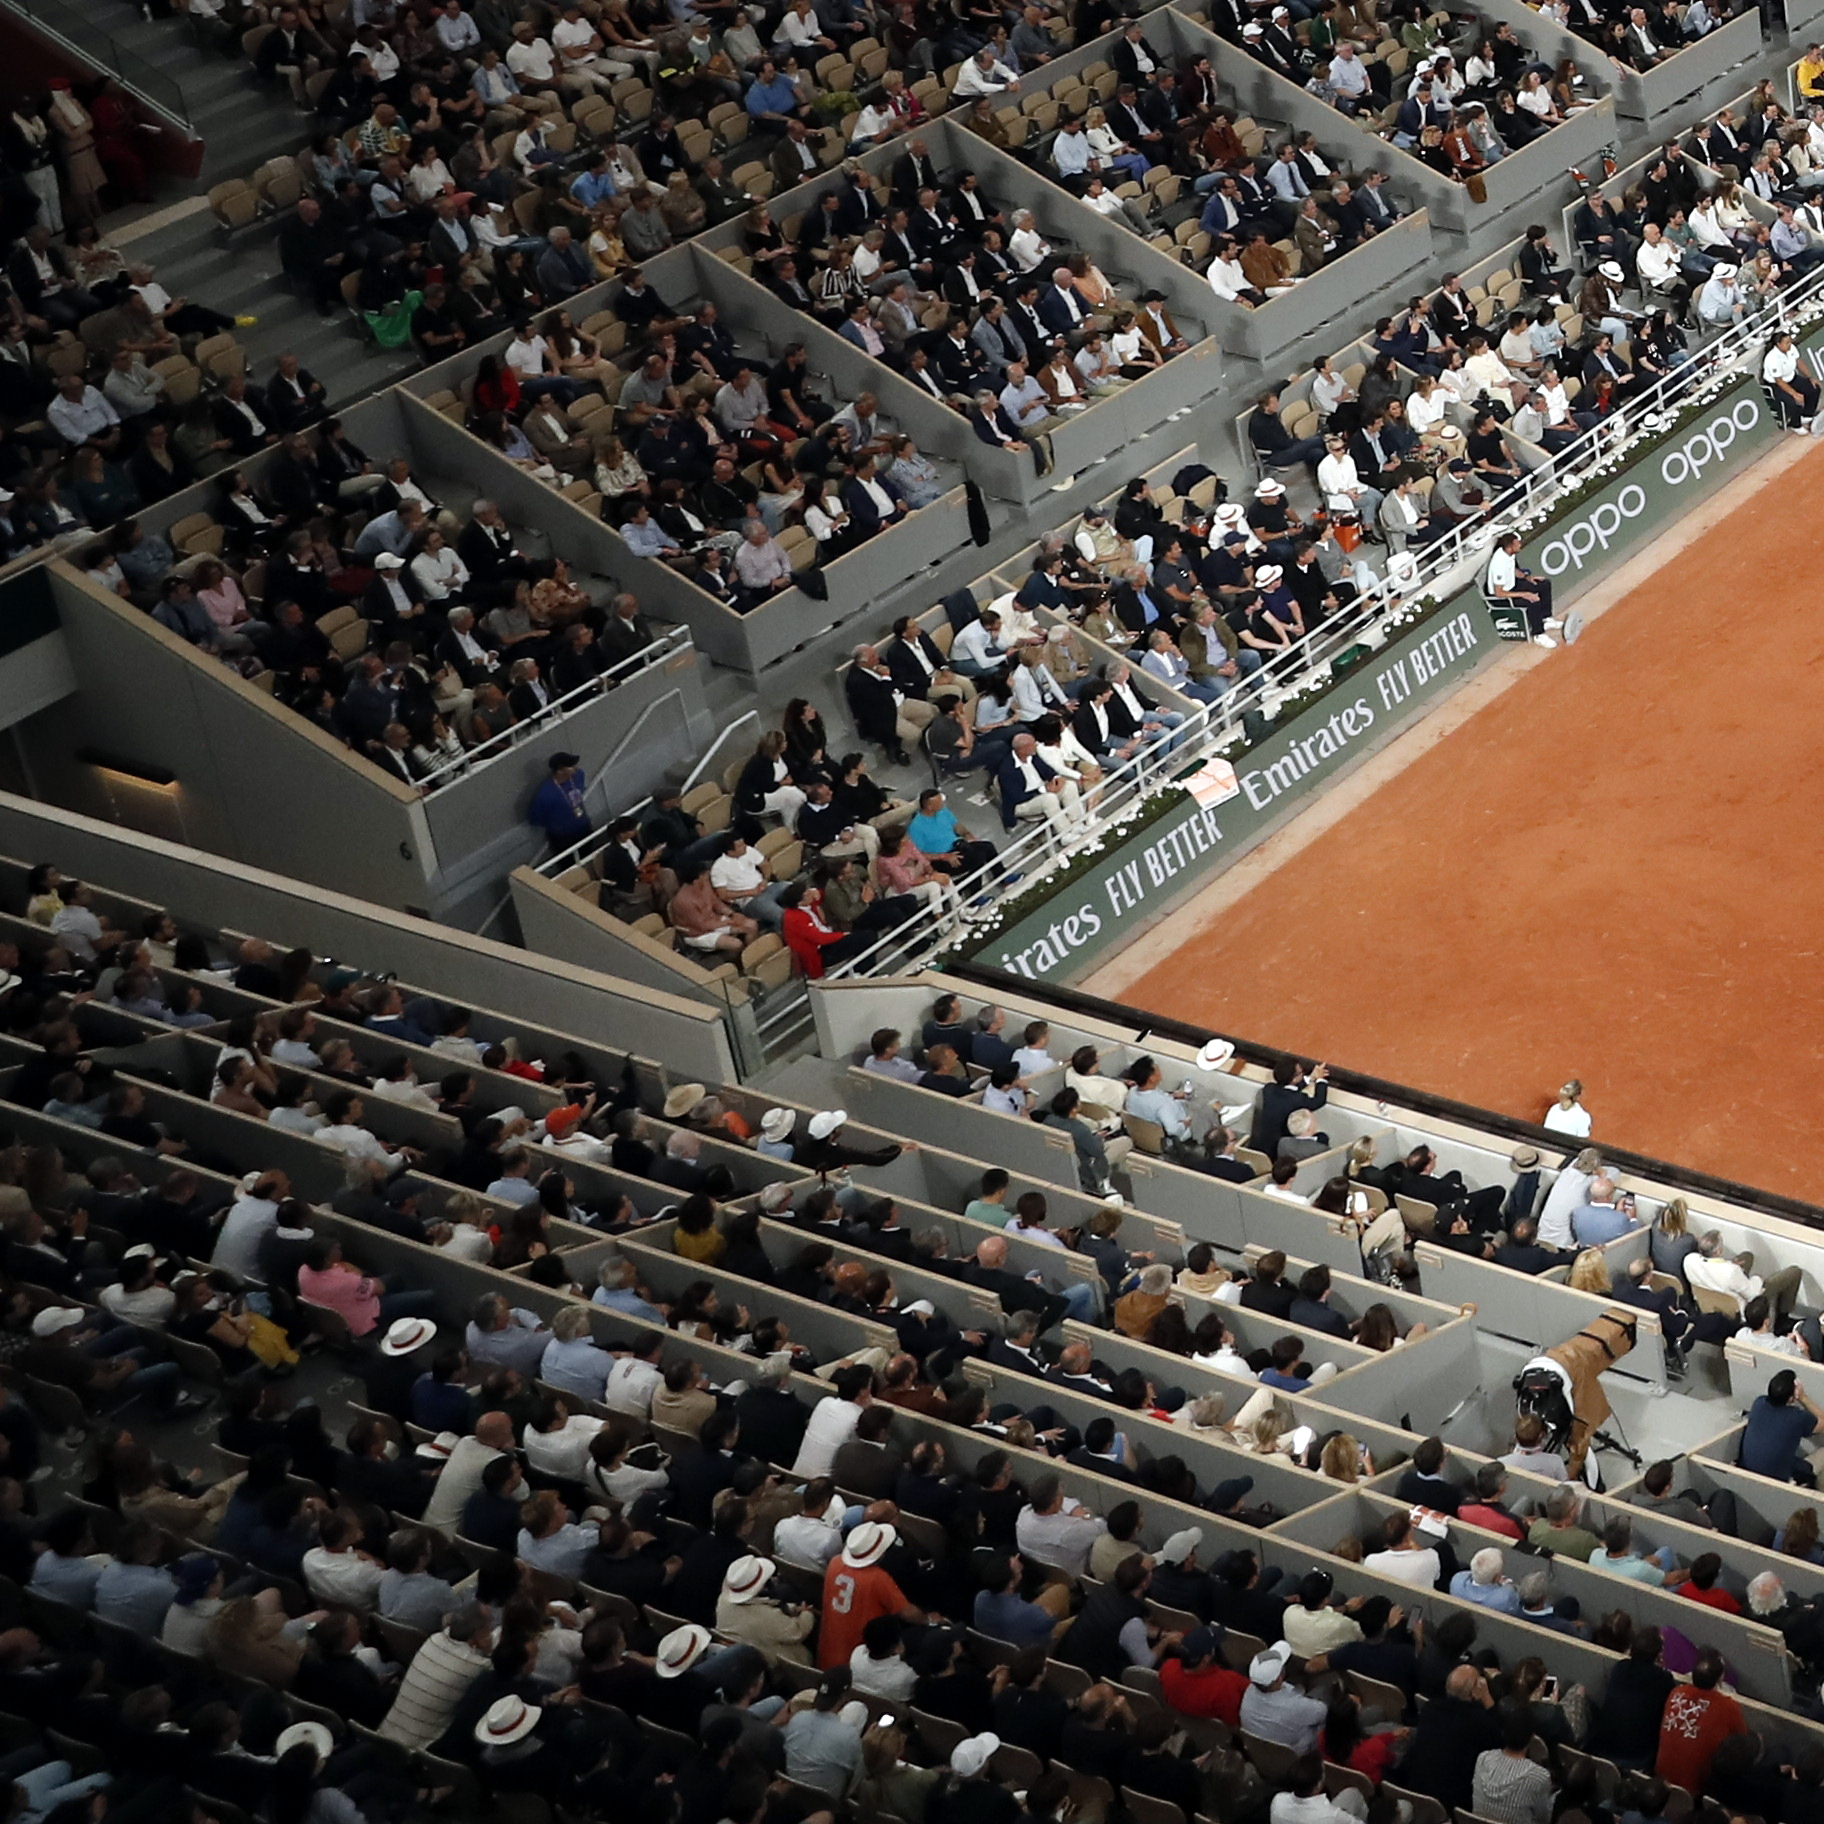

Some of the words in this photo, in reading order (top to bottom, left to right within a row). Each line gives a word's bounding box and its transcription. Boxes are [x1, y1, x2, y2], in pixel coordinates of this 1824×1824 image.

[1661, 399, 1759, 484] oppo
[1540, 484, 1646, 577] oppo
[1498, 630, 1525, 638] COSTE
[1239, 697, 1374, 811] Emirates
[1376, 659, 1407, 712] FLY
[1410, 612, 1477, 684] BETTER
[400, 842, 412, 861] 6
[1002, 904, 1101, 981] irates
[1105, 863, 1147, 918] FLY
[1145, 807, 1223, 889] BETTER
